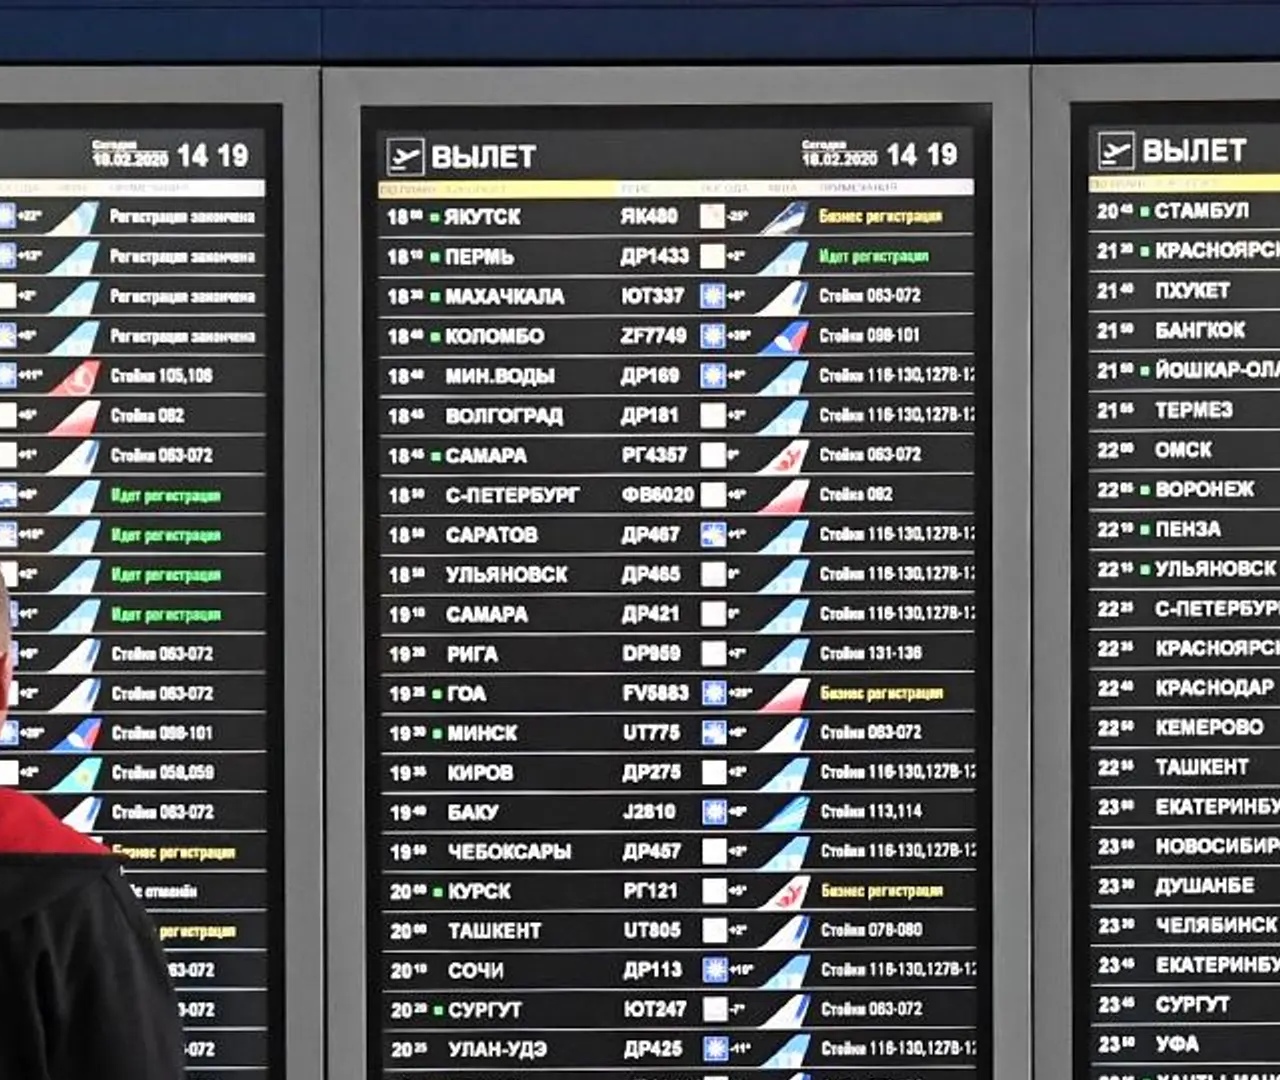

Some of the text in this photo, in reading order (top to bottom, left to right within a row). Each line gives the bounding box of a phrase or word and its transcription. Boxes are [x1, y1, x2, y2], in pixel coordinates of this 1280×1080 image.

[178, 143, 248, 167] 14 19
[432, 145, 536, 168] ВЫЛЕТ
[802, 151, 878, 166] 18.02.2020
[888, 142, 957, 166] 14 19
[1144, 138, 1247, 162] ВЫЛЕТ
[444, 208, 520, 225] ЯКУТСК
[1155, 202, 1249, 219] СТАМБУЛ
[446, 248, 514, 265] ПЕРМЬ
[620, 247, 689, 267] ДР1433
[446, 288, 564, 304] МАХАЧКАЛА
[622, 287, 684, 304] ЮТ337
[1156, 282, 1230, 299] ПХУКЕТ
[446, 327, 687, 344] КОЛОМБО ZF7749
[1156, 321, 1245, 339] БАНГКОК
[446, 368, 555, 387] МИН.ВОДЫ
[446, 407, 563, 426] ВОЛГОГРАД
[1156, 401, 1233, 418] ТЕРМЕЗ
[446, 446, 687, 463] САМАРА РГ4357
[1156, 441, 1212, 458] ОМСК
[446, 487, 580, 503] С-ПЕТЕРБУРГ
[1156, 481, 1254, 497] ВОРОНЕЖ
[446, 526, 538, 543] САРАТОВ
[1157, 521, 1221, 537] ПЕНЗА
[446, 566, 567, 583] УЛЬЯНОВСК
[1155, 560, 1276, 577] УЛЬЯНОВСК
[447, 605, 678, 624] САМАРА ДР421
[448, 646, 498, 662] РИГА
[448, 686, 486, 701] ГОА
[1157, 679, 1274, 697] КРАСНОДАР
[448, 724, 680, 741] МИНСК UT775
[1157, 719, 1264, 735] КЕМЕРОВО
[449, 764, 681, 782] КИРОВ ДР275
[1156, 758, 1249, 775] ТАШКЕНТ
[449, 804, 499, 820] БАКУ
[870, 804, 922, 819] 113,114
[449, 843, 571, 860] ЧЕБОКСАРЫ
[449, 882, 676, 899] КУРСК РГ121
[1155, 877, 1254, 896] ДУШАНБЕ
[448, 923, 541, 939] ТАШКЕНТ
[1157, 917, 1277, 933] ЧЕЛЯБИНСК
[449, 961, 682, 980] СОЧИ ДР113
[449, 1001, 686, 1018] СУРГУТ ЮТ247
[1156, 996, 1230, 1013] СУРГУТ
[449, 1040, 682, 1059] УЛАН-УДЭ ДР425
[1156, 1035, 1199, 1052] УФА
